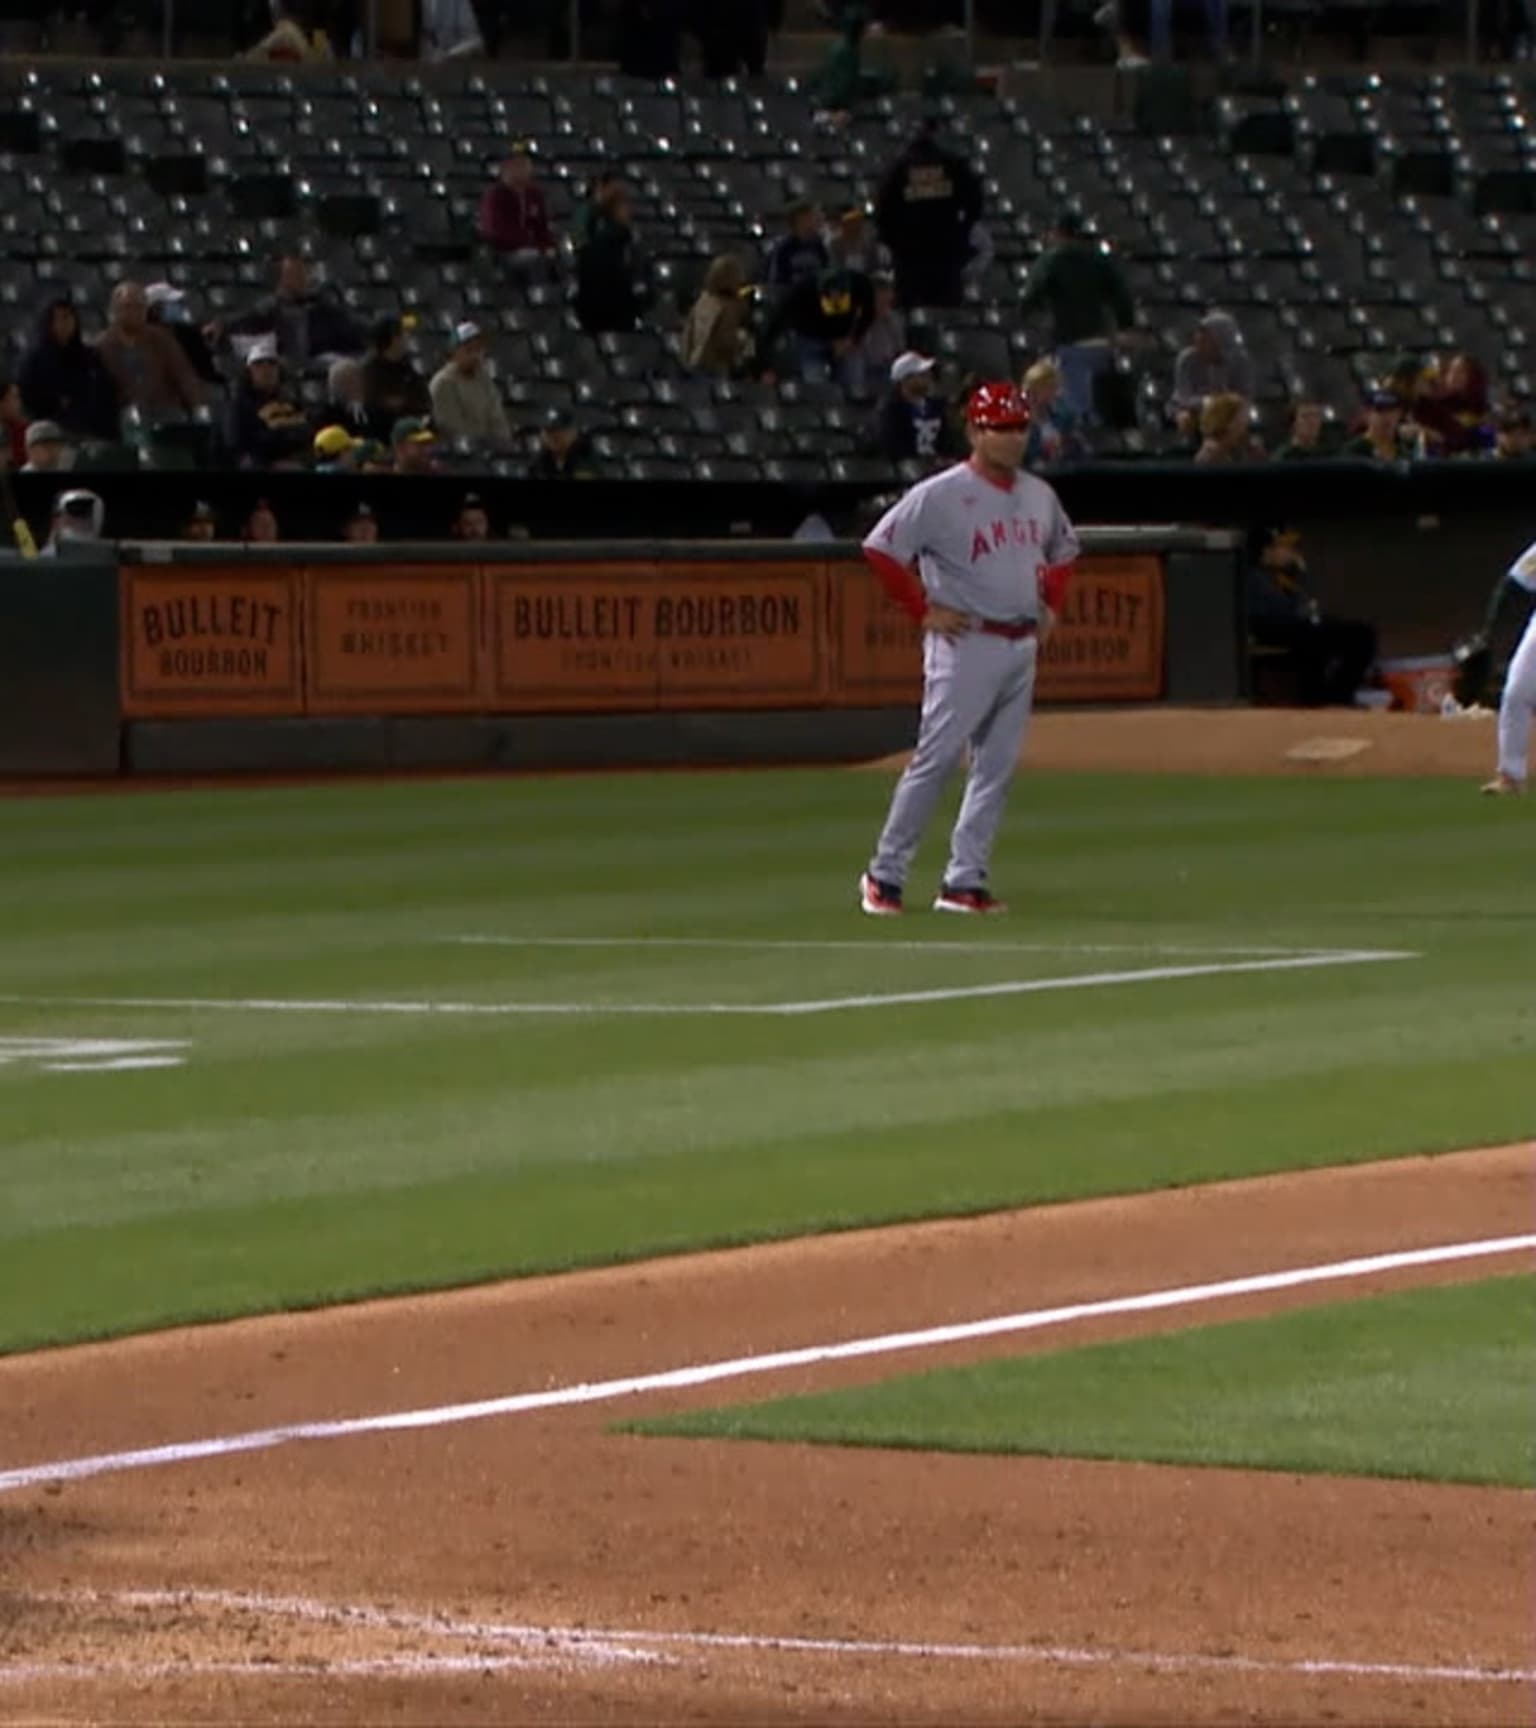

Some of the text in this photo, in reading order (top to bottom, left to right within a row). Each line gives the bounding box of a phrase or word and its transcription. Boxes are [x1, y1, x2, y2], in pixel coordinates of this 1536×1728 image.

[143, 595, 279, 646] BULLEIT
[514, 594, 800, 640] BULLEIT BOURBON
[1060, 587, 1144, 633] LLEIT
[160, 647, 268, 680] BOURBON
